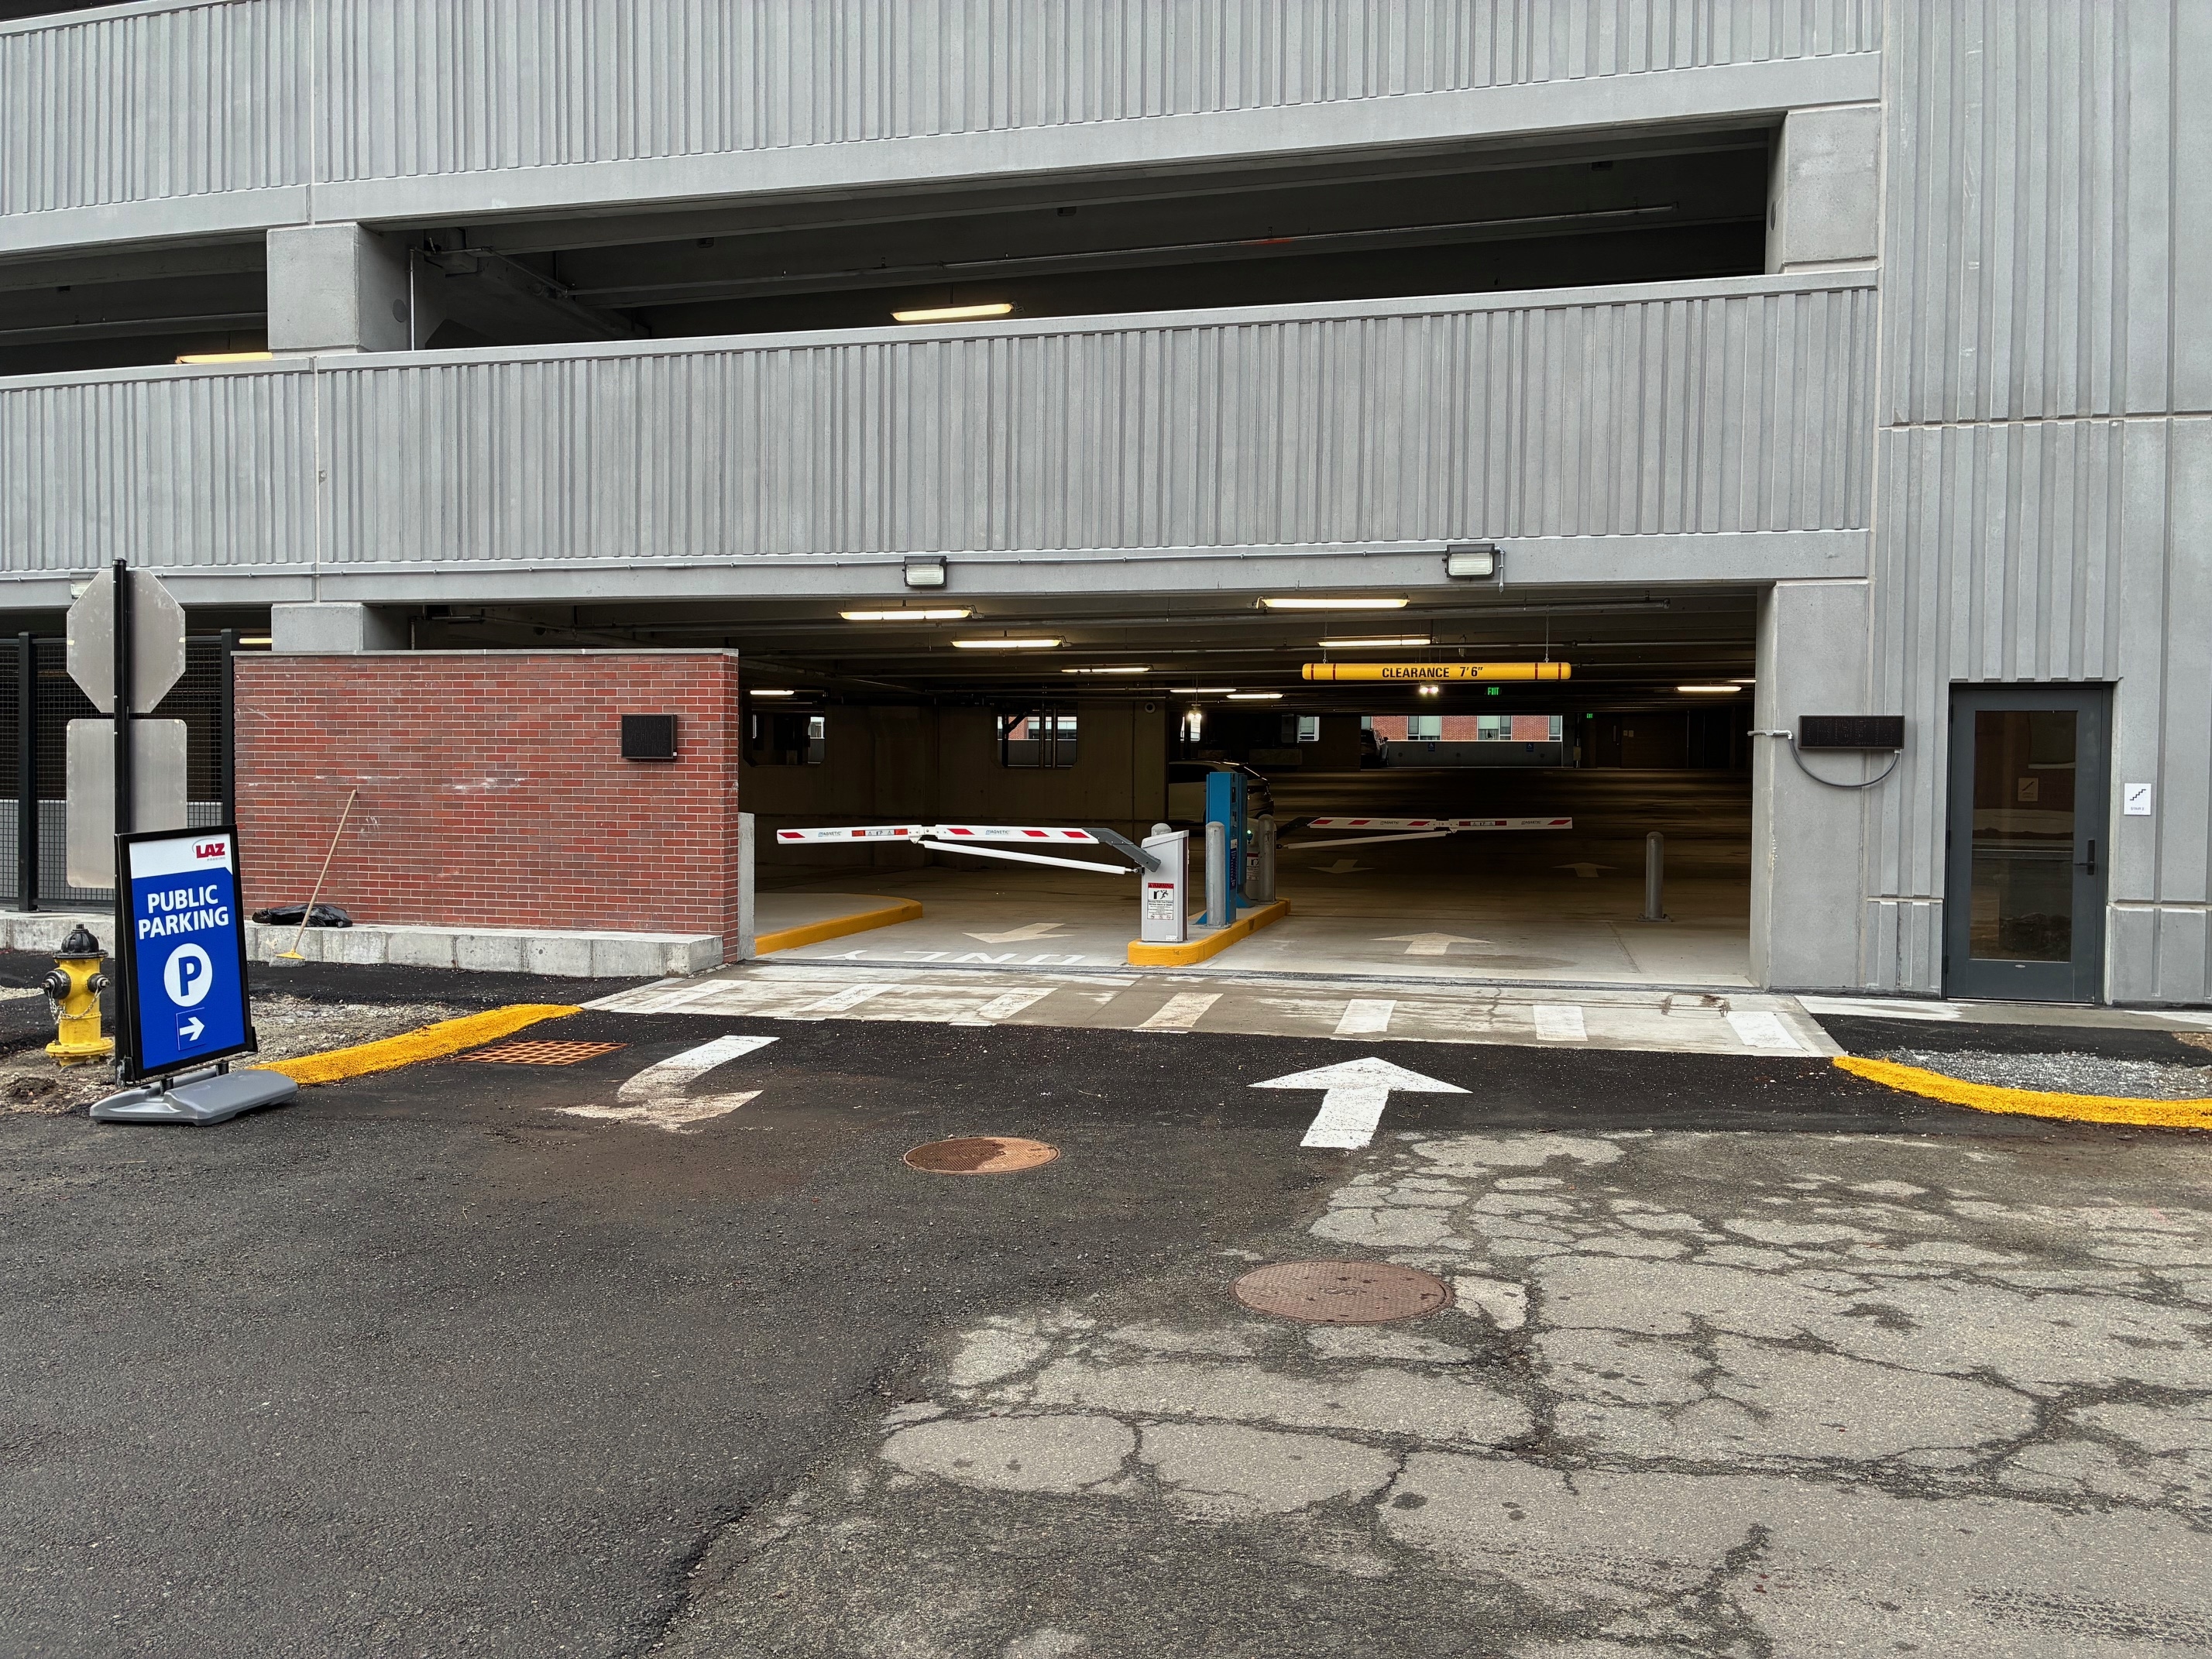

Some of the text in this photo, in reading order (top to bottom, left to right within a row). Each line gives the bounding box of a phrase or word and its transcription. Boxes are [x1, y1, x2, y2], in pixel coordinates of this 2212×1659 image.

[1382, 667, 1450, 678] CLEARANCE
[196, 843, 225, 858] LAZ
[147, 884, 218, 914] PUBLIC
[138, 906, 229, 940] PARKING
[178, 955, 202, 998] P
